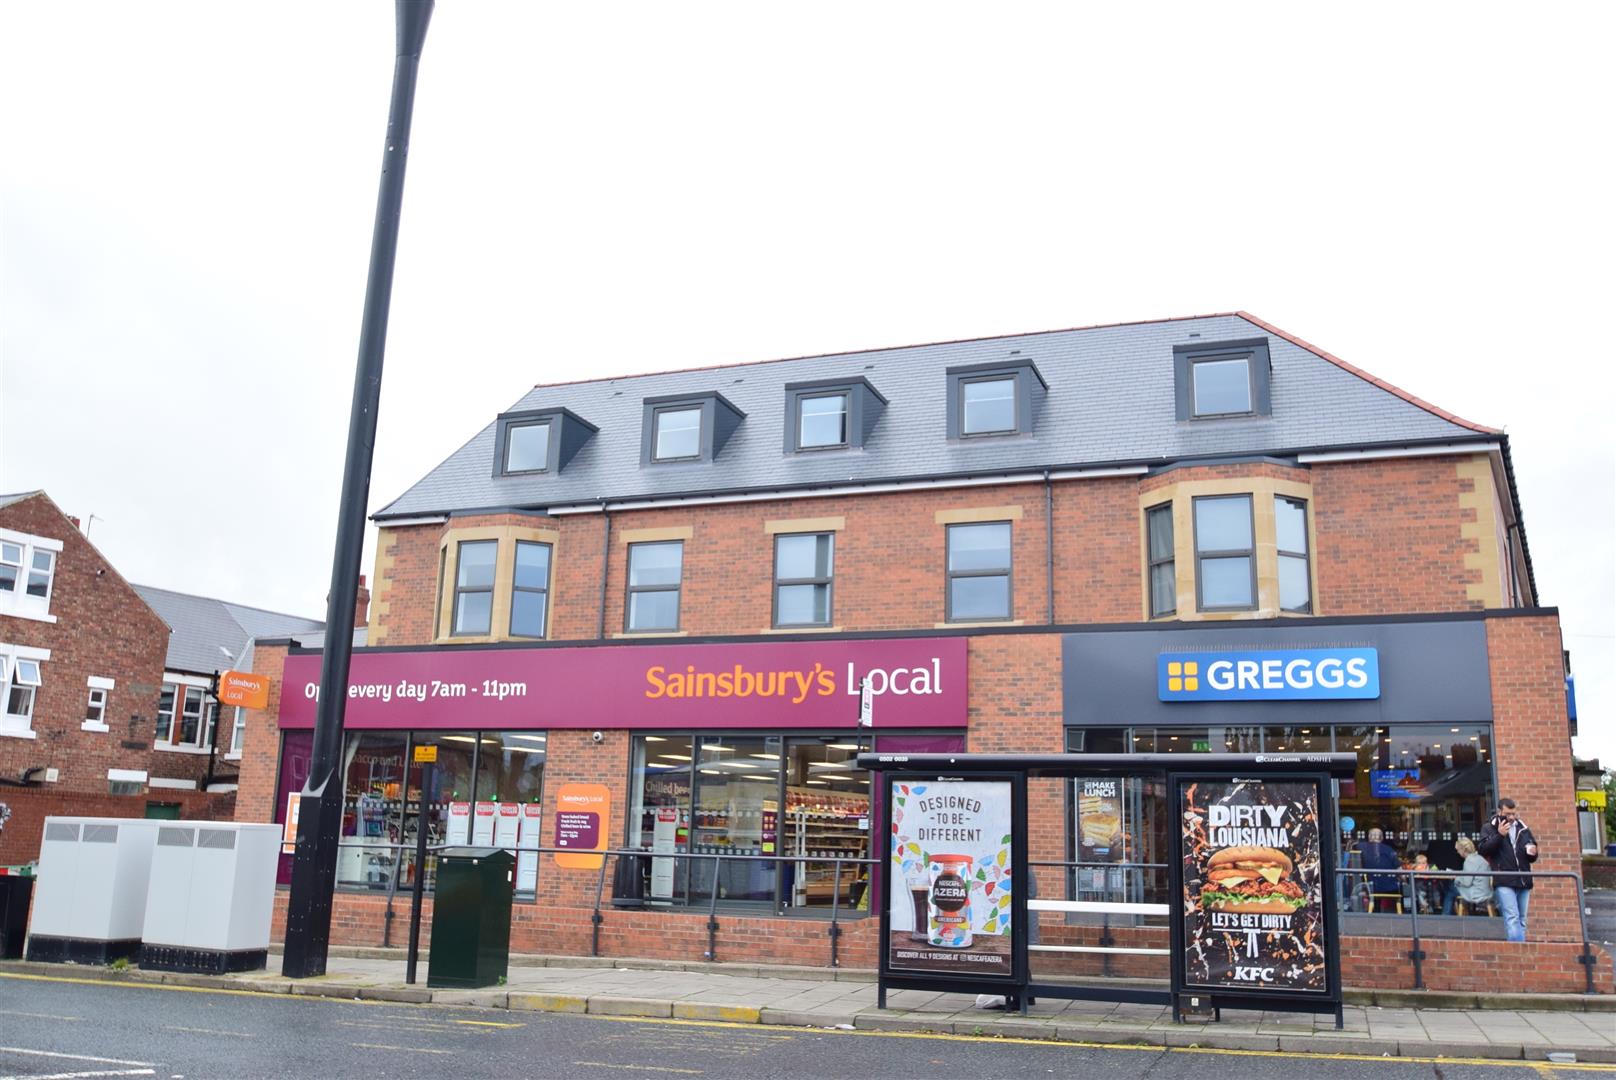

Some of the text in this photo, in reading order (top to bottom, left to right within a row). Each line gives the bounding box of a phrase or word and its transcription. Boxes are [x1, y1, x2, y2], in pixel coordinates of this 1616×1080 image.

[646, 662, 836, 704] Sainsbury's
[847, 657, 943, 696] Local
[1207, 657, 1368, 691] GREGGS
[228, 677, 260, 689] Sainsbury's
[348, 684, 393, 702] every
[396, 679, 427, 702] day
[431, 680, 467, 697] 7am
[482, 679, 527, 701] 11pm
[226, 690, 243, 700] Local
[1084, 788, 1116, 797] LUNCH
[1091, 781, 1116, 789] MAKE
[919, 795, 982, 813] DESIGNED
[1208, 804, 1288, 828] DIRTY
[918, 828, 982, 842] DIFFERENT
[1208, 827, 1290, 848] LOUISIANA
[934, 888, 967, 897] AZERA
[1211, 912, 1292, 929] LET'S GET DIRTY
[896, 950, 919, 959] DISCOVER
[919, 952, 928, 960] ALL
[1233, 966, 1275, 982] KFC
